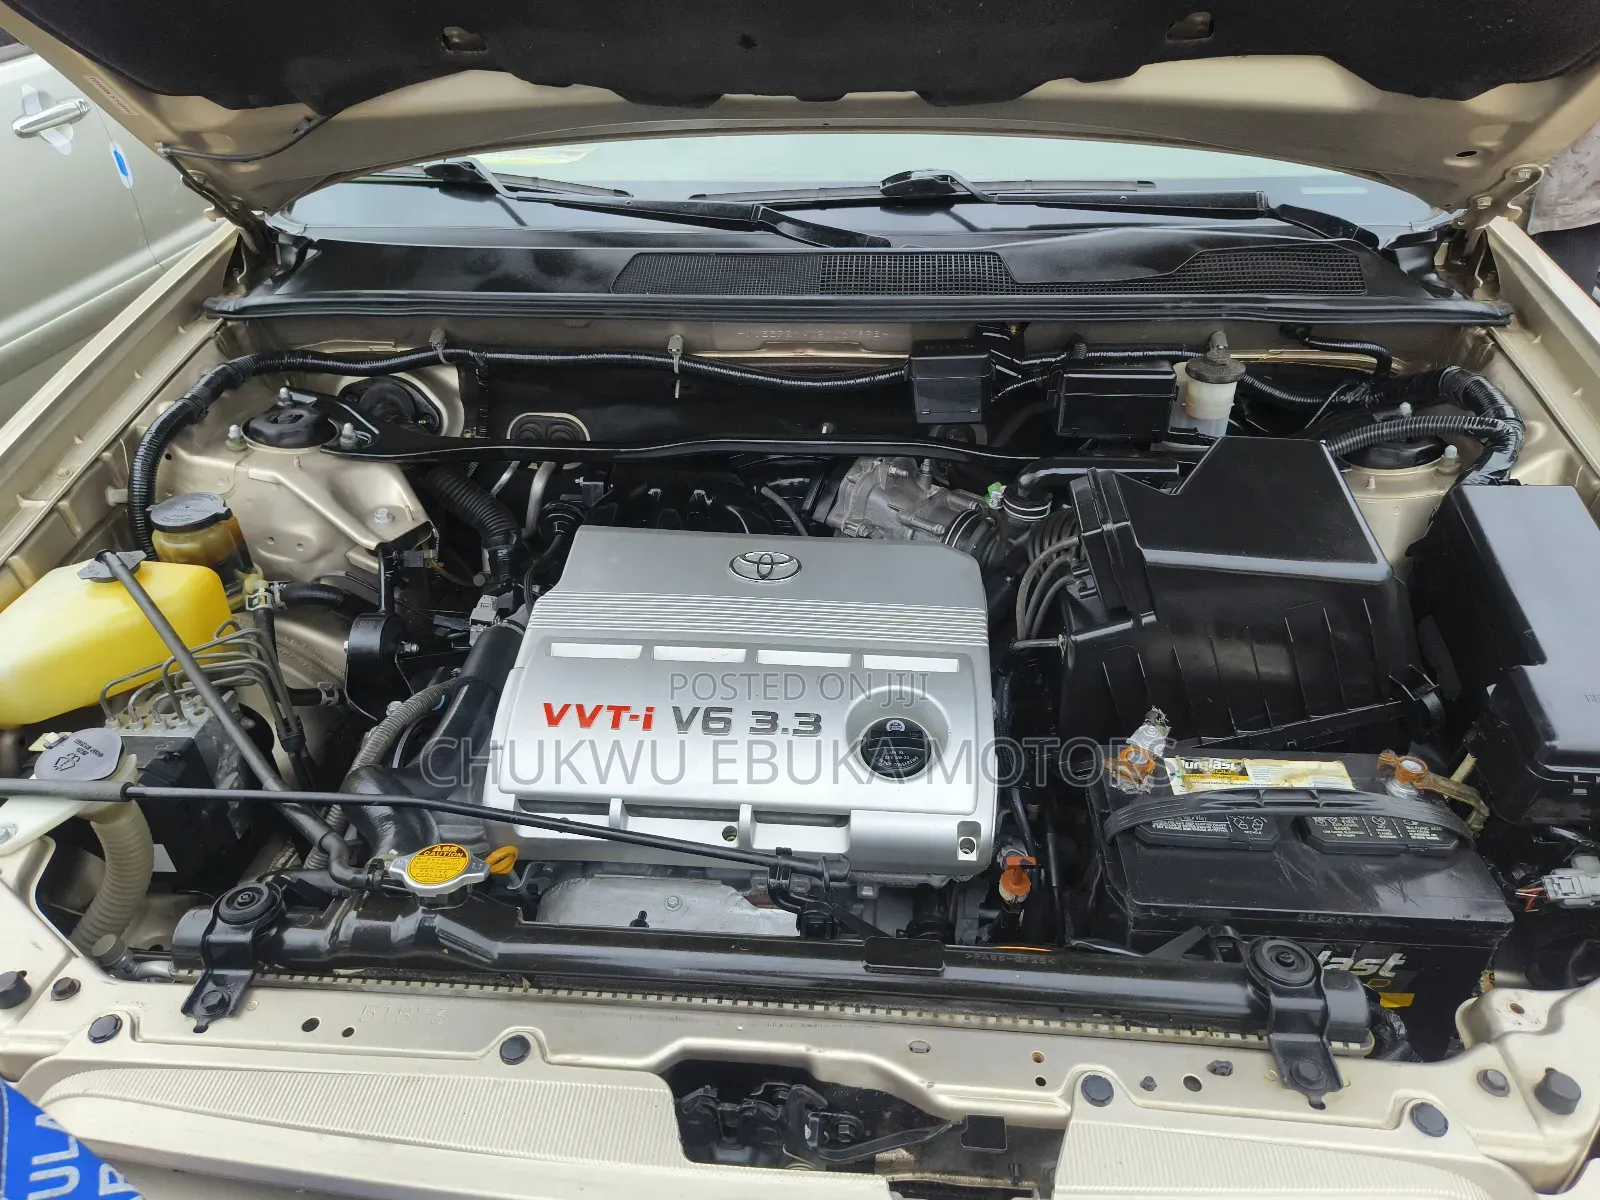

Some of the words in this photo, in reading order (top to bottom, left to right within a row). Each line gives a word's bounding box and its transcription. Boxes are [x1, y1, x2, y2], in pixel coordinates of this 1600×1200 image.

[543, 702, 656, 731] VVT-i
[671, 706, 733, 735] V6
[749, 710, 823, 737] 3.3
[423, 850, 464, 858] CAUTION
